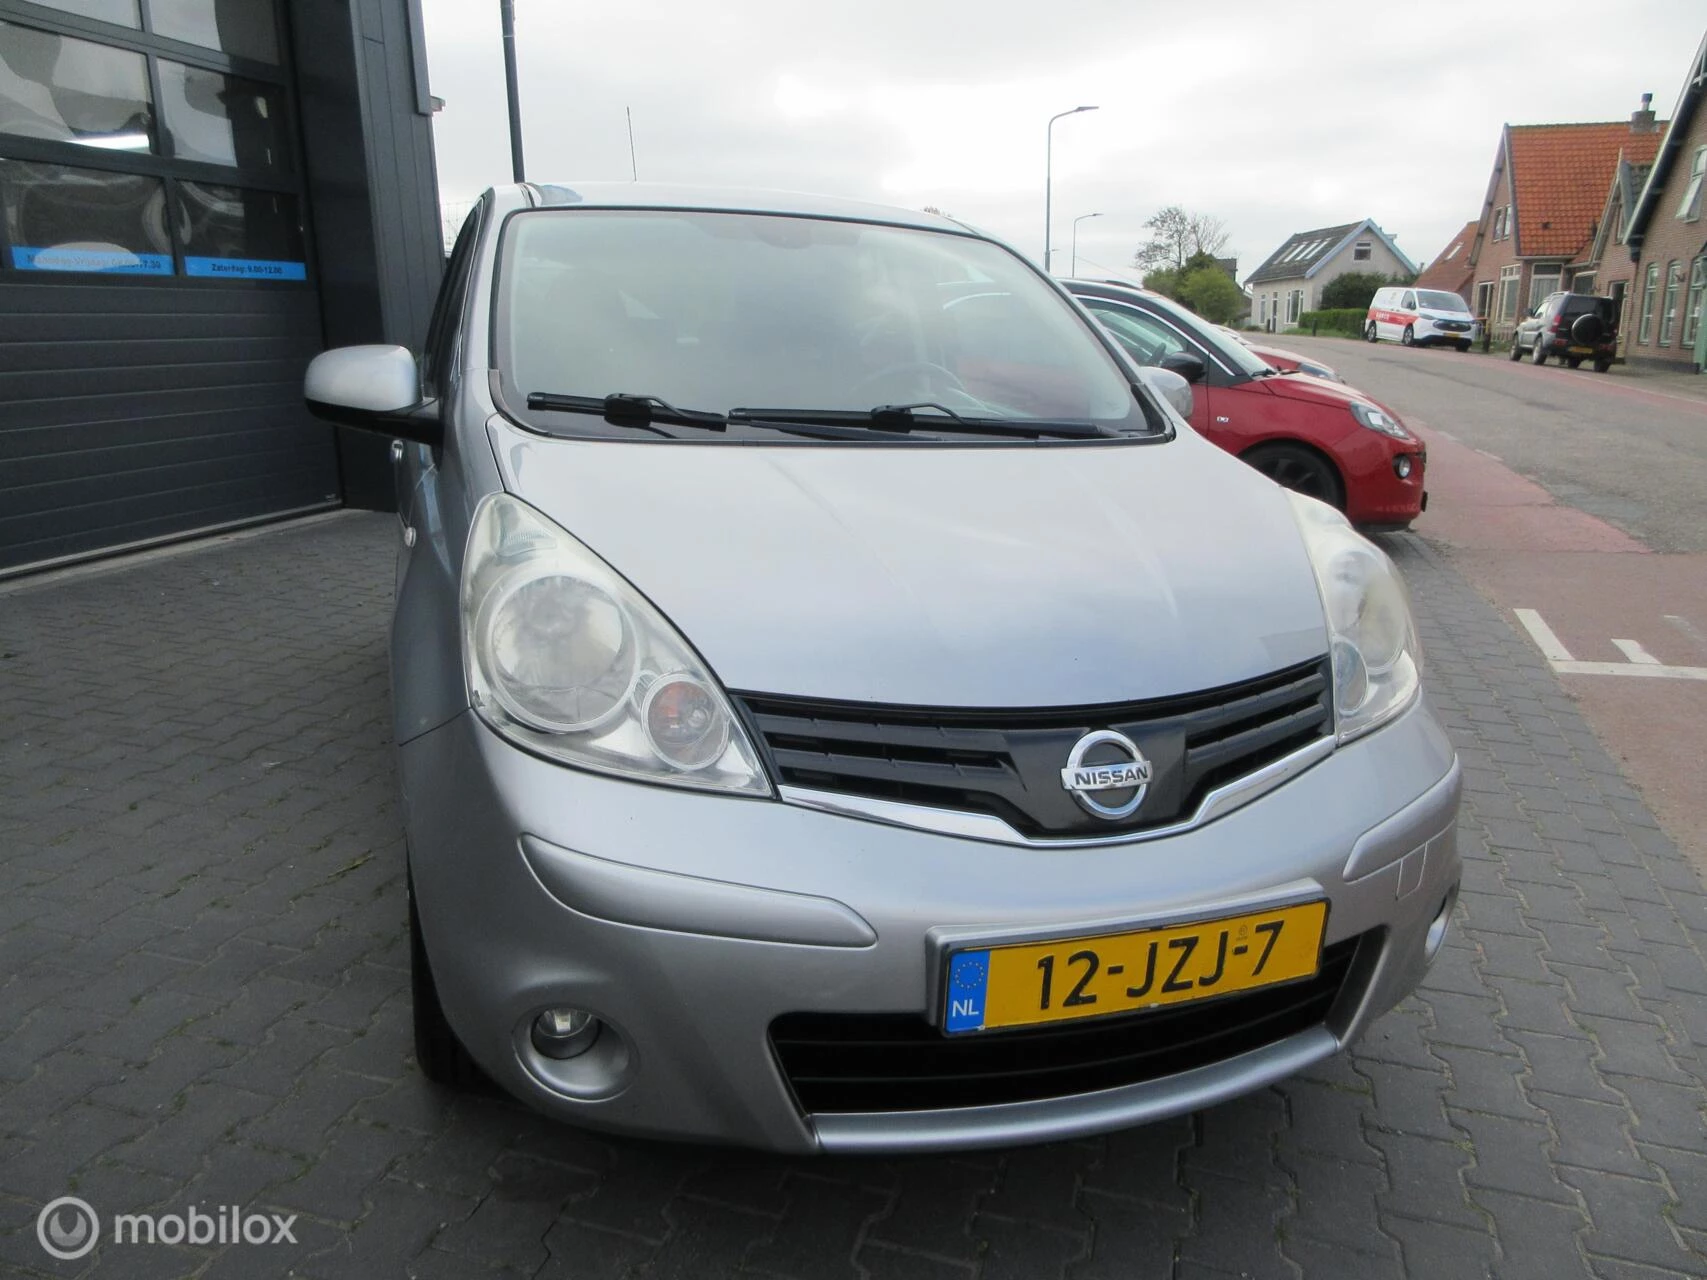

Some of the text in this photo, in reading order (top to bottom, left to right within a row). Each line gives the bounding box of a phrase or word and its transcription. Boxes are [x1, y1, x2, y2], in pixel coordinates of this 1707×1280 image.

[1074, 766, 1149, 786] NISSAN
[1037, 919, 1285, 1010] 12-JZJ-7
[951, 999, 980, 1018] NL
